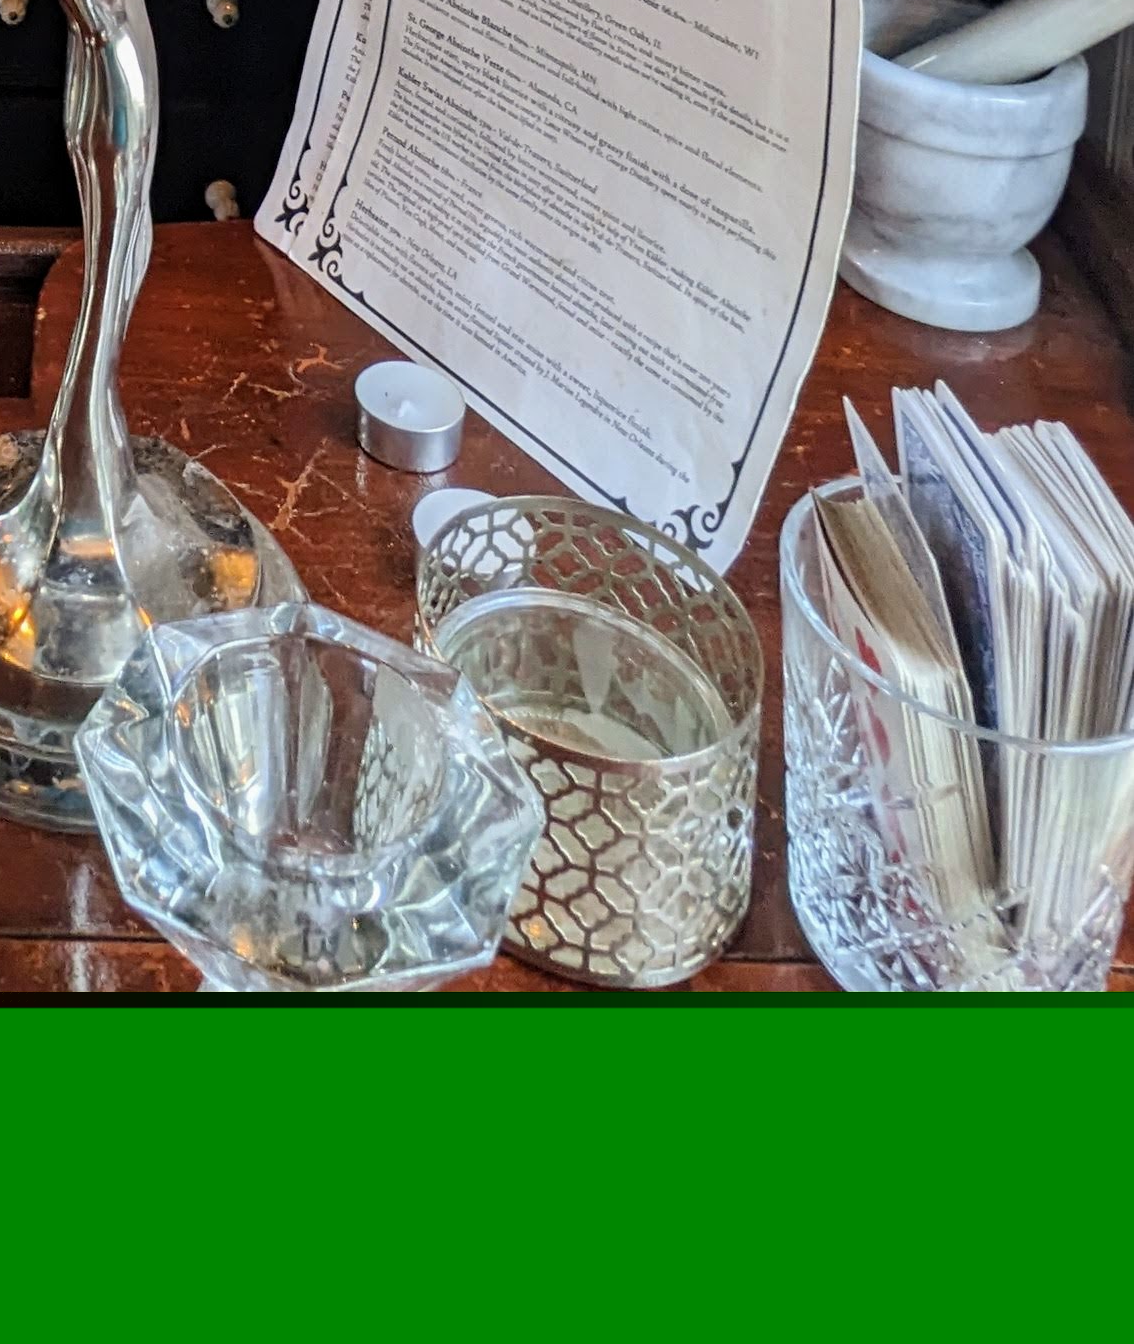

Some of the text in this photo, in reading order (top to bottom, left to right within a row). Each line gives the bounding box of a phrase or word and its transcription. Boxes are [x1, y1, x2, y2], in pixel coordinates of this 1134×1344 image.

[417, 18, 446, 40] George
[445, 34, 481, 60] Absinthe
[562, 100, 579, 115] CA
[444, 94, 479, 122] Absinthe
[381, 127, 407, 149] Pernod
[407, 142, 441, 170] Absinthe
[582, 126, 599, 142] and
[700, 196, 710, 207] of
